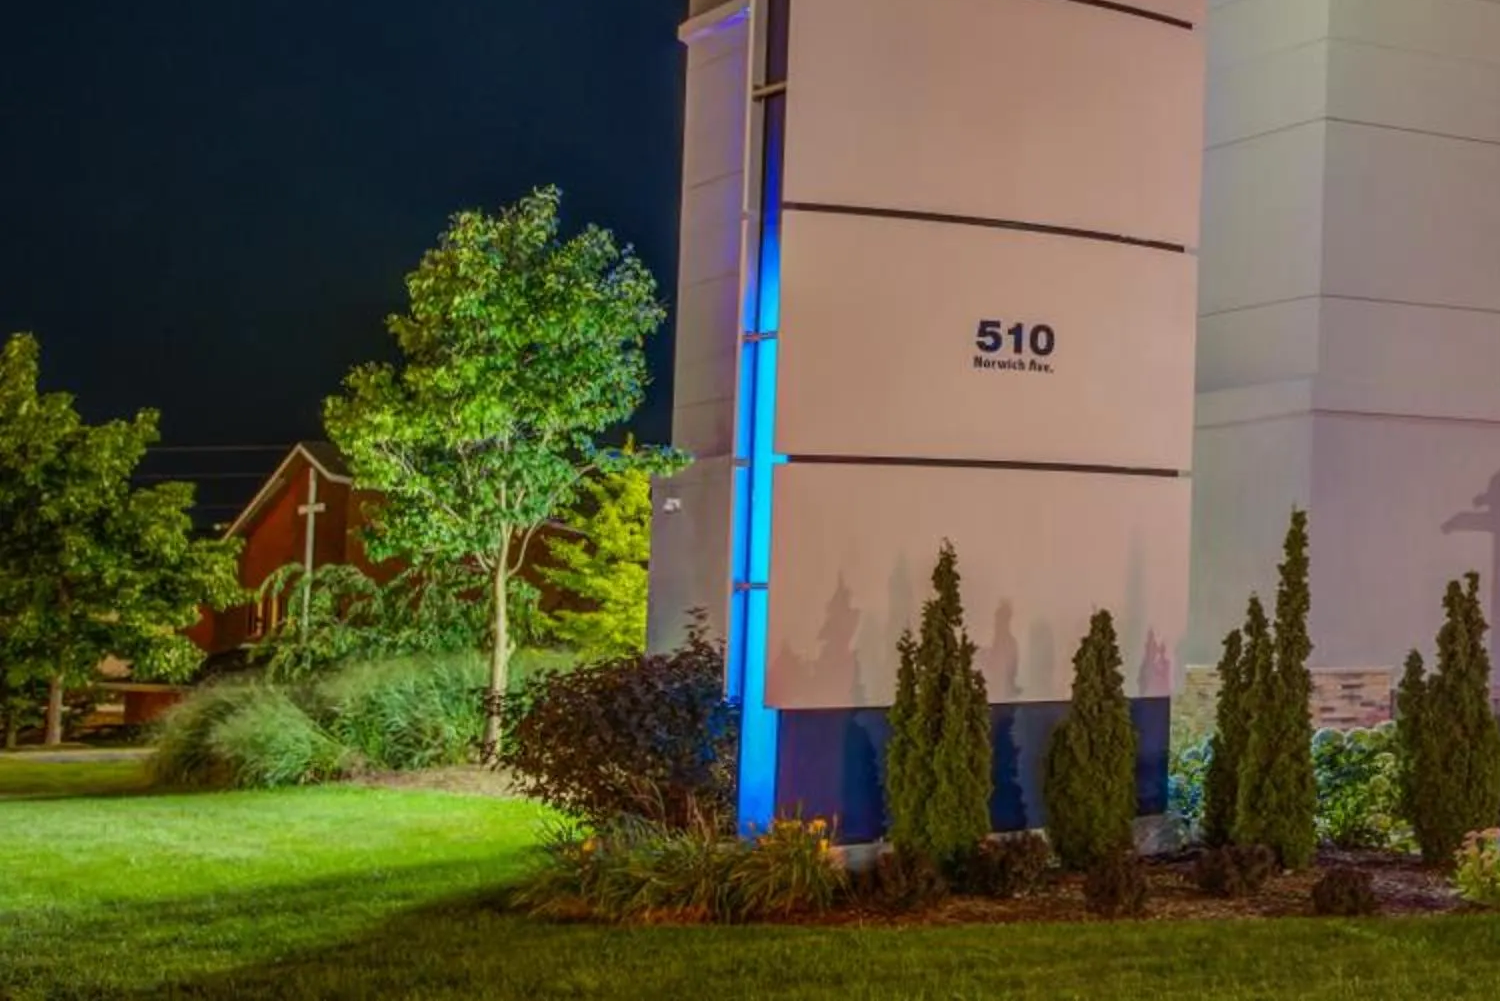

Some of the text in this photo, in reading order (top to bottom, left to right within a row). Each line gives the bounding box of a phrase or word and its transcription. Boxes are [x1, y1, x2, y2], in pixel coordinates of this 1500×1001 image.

[975, 320, 1055, 356] 510
[973, 355, 1055, 374] Norwich Ave.
